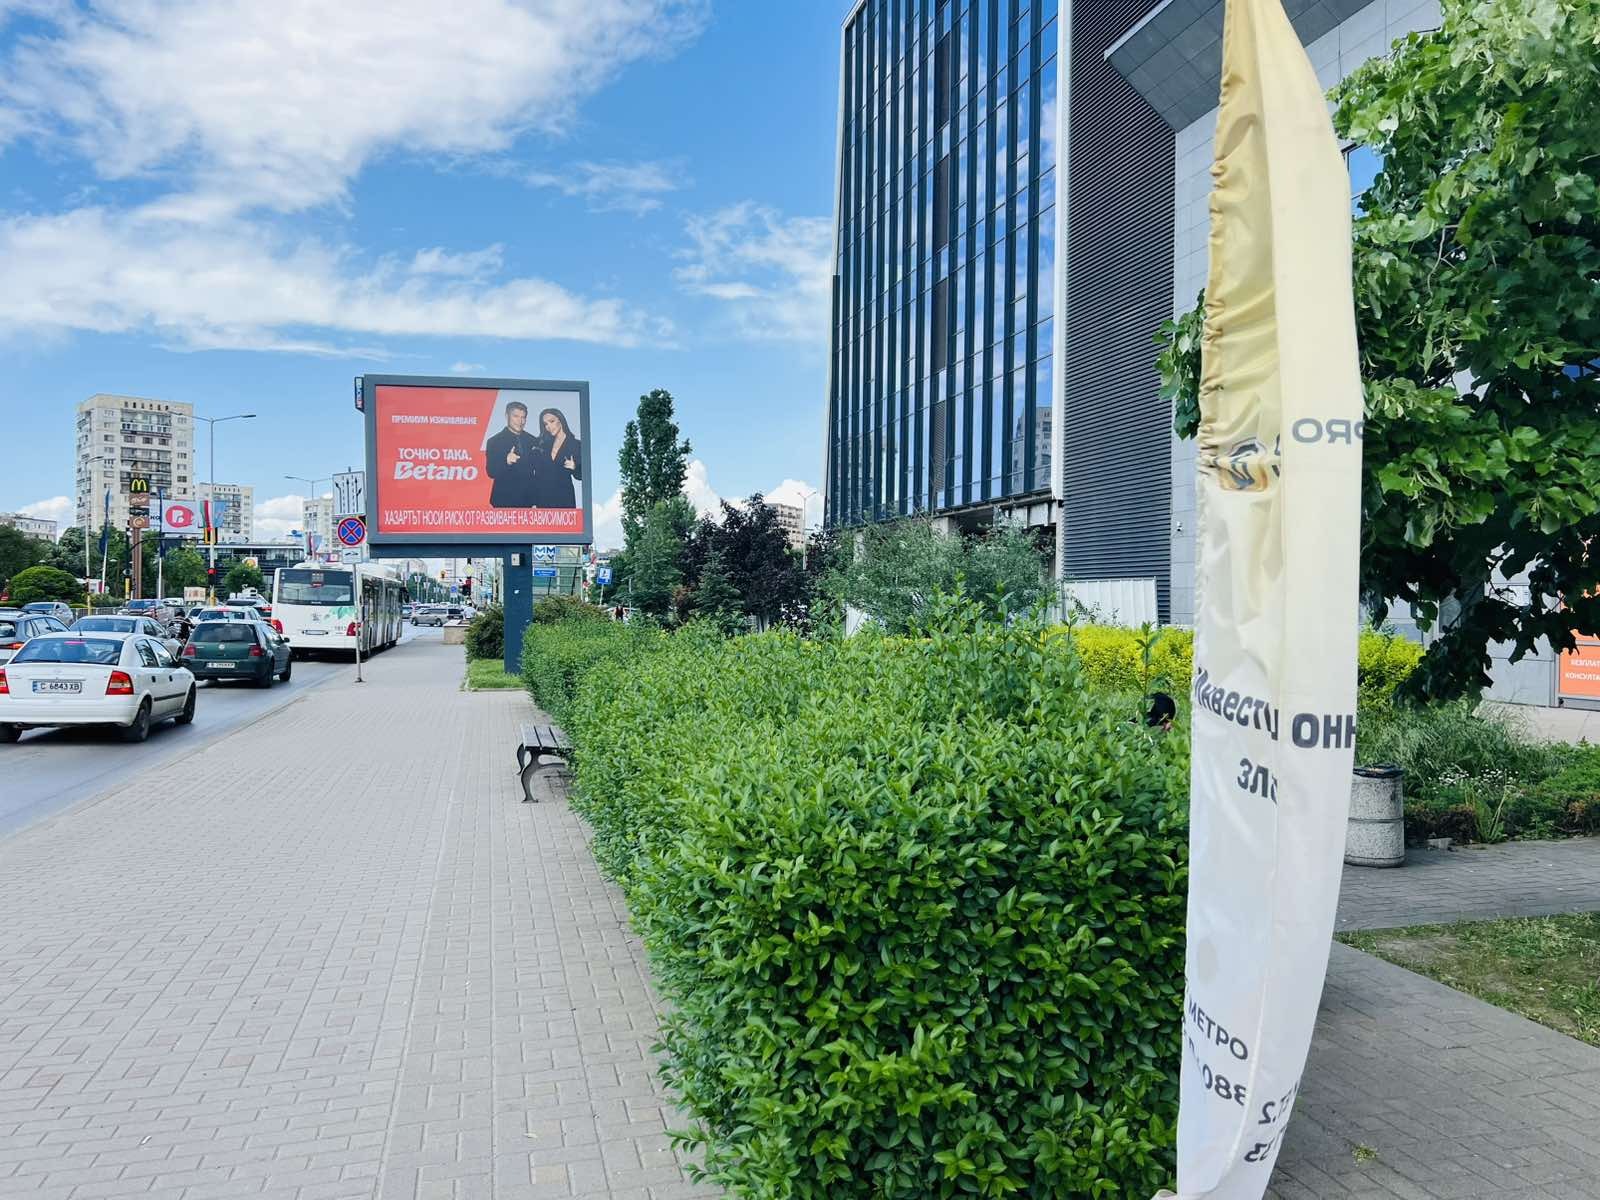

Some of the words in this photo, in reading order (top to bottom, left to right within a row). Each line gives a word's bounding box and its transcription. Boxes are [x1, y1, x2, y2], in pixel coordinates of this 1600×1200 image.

[398, 447, 440, 460] ТОЧНО
[442, 448, 472, 461] ТАКА.
[393, 461, 478, 480] Betano
[384, 510, 421, 525] ХАЗАРТЪТ
[422, 510, 444, 525] НОСИ
[444, 510, 464, 525] РИСК
[464, 510, 475, 525] ОТ
[476, 510, 517, 526] РАЗВИВАНЕ
[517, 510, 528, 525] НА
[529, 511, 577, 526] ЗАВИСИМОСТ
